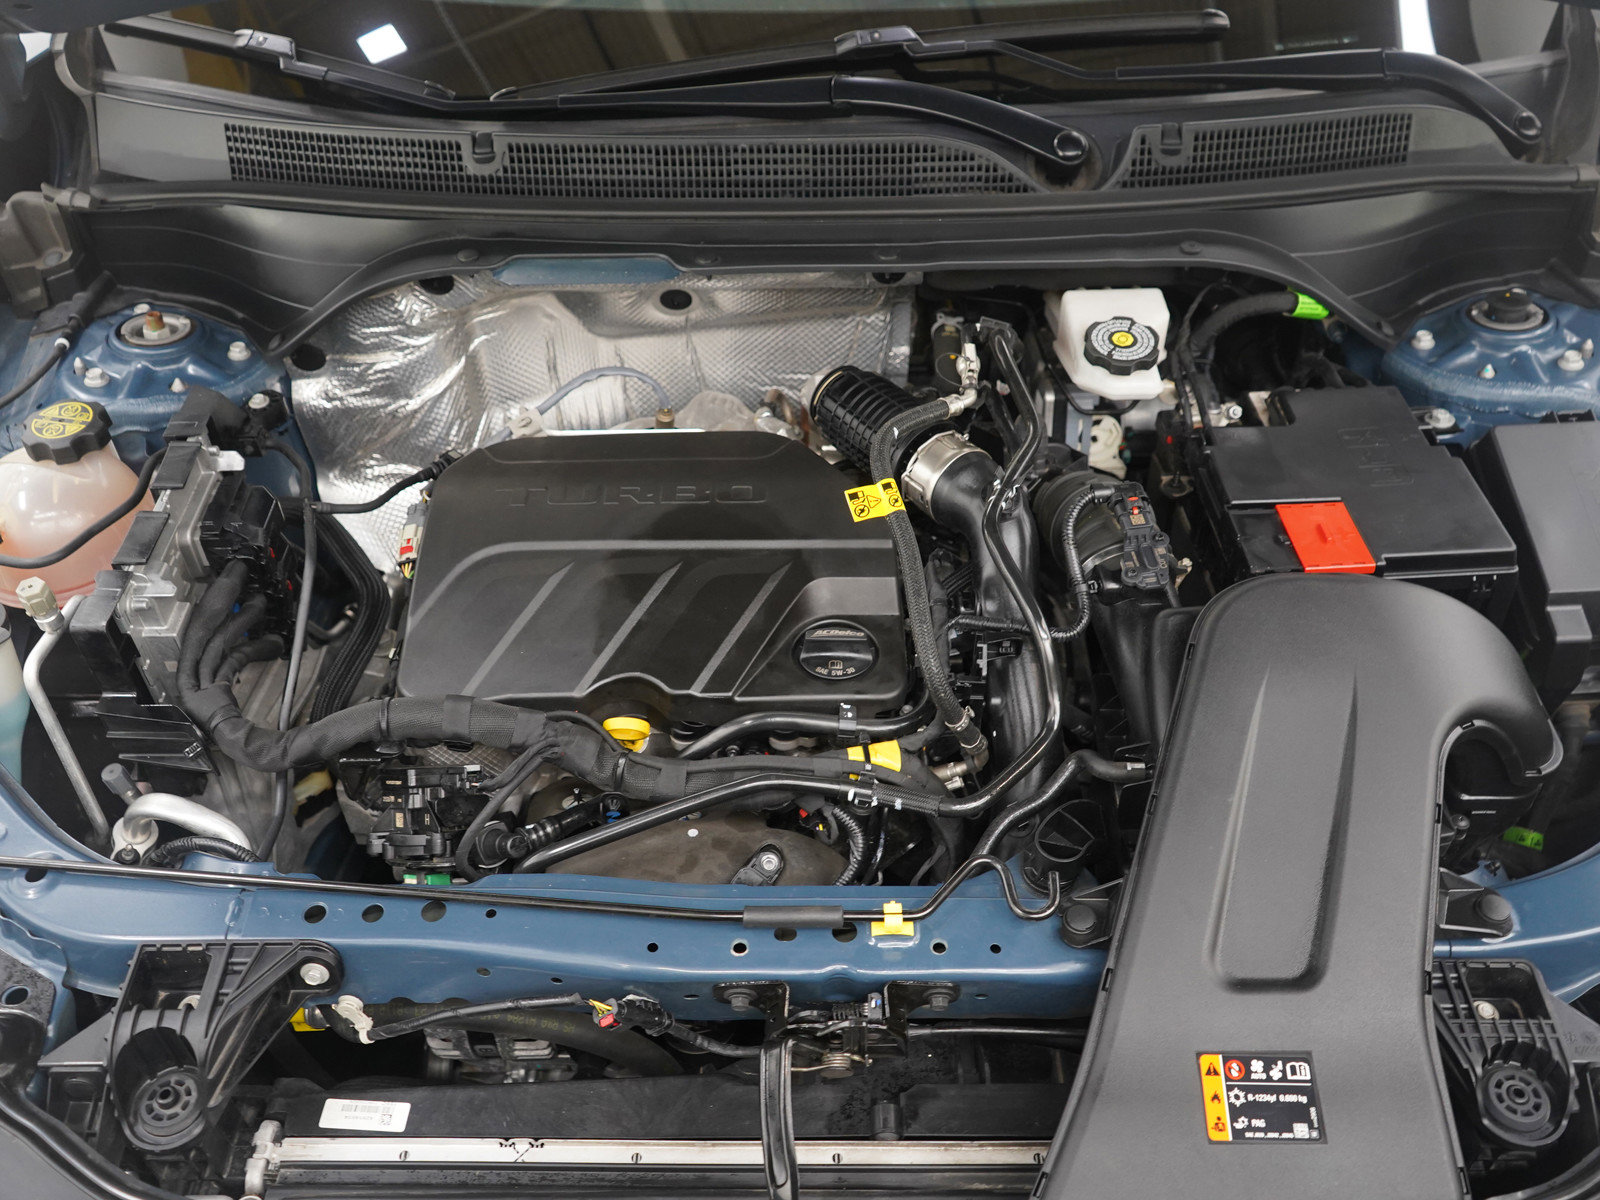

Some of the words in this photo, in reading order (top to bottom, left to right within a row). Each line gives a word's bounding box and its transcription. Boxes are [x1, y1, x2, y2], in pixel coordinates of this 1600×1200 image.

[496, 484, 768, 507] TURBO
[811, 629, 865, 638] ACDelco
[815, 666, 829, 676] SAE
[831, 667, 856, 676] 5W-30
